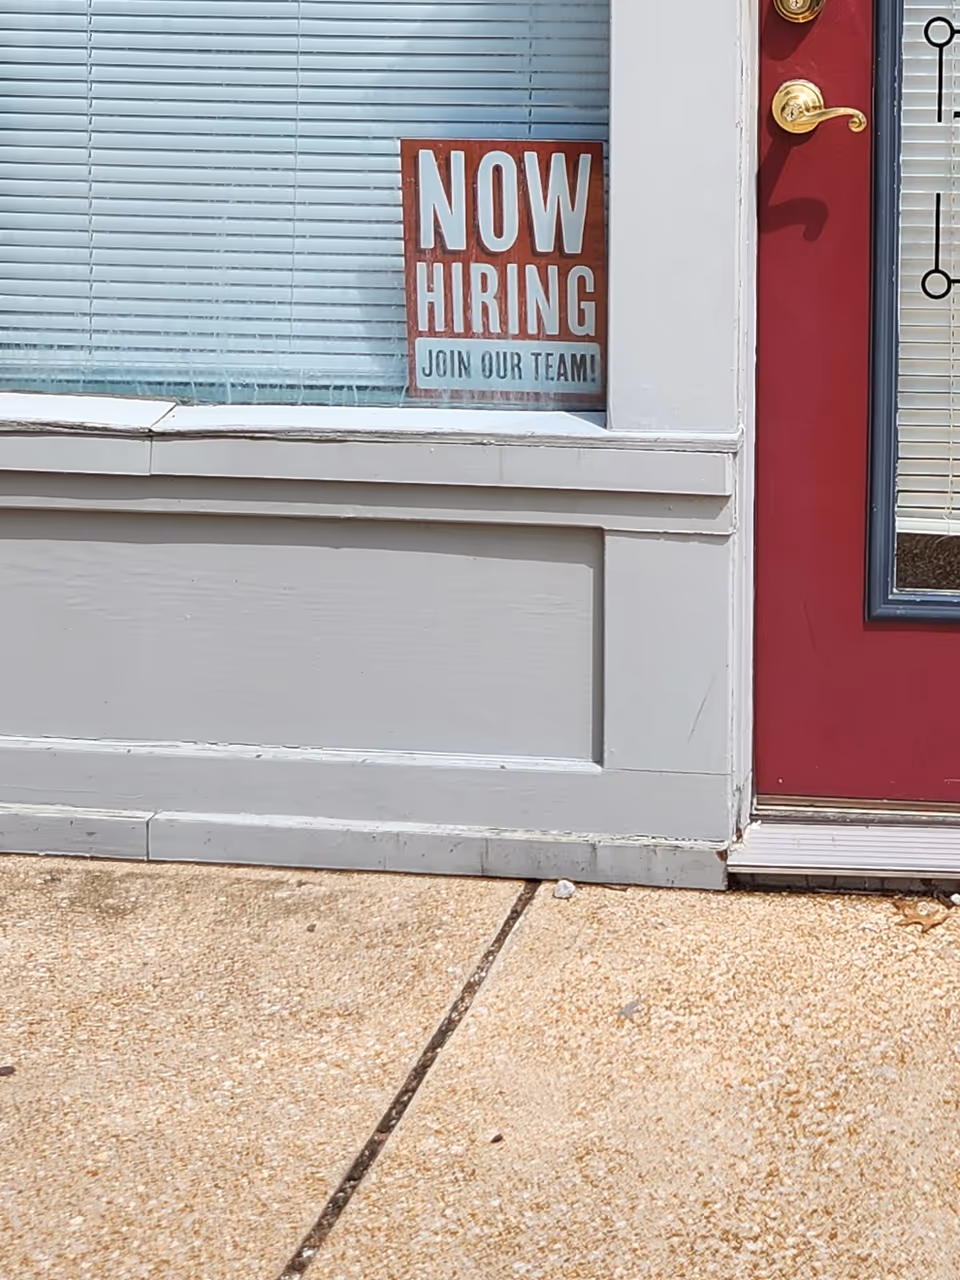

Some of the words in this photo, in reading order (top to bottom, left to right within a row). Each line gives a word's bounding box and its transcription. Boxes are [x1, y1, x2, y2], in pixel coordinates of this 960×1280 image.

[418, 149, 592, 254] NOW
[416, 262, 596, 337] HIRING
[421, 349, 471, 379] JOIN
[481, 351, 522, 380] OUR
[530, 352, 597, 383] TEAM!
